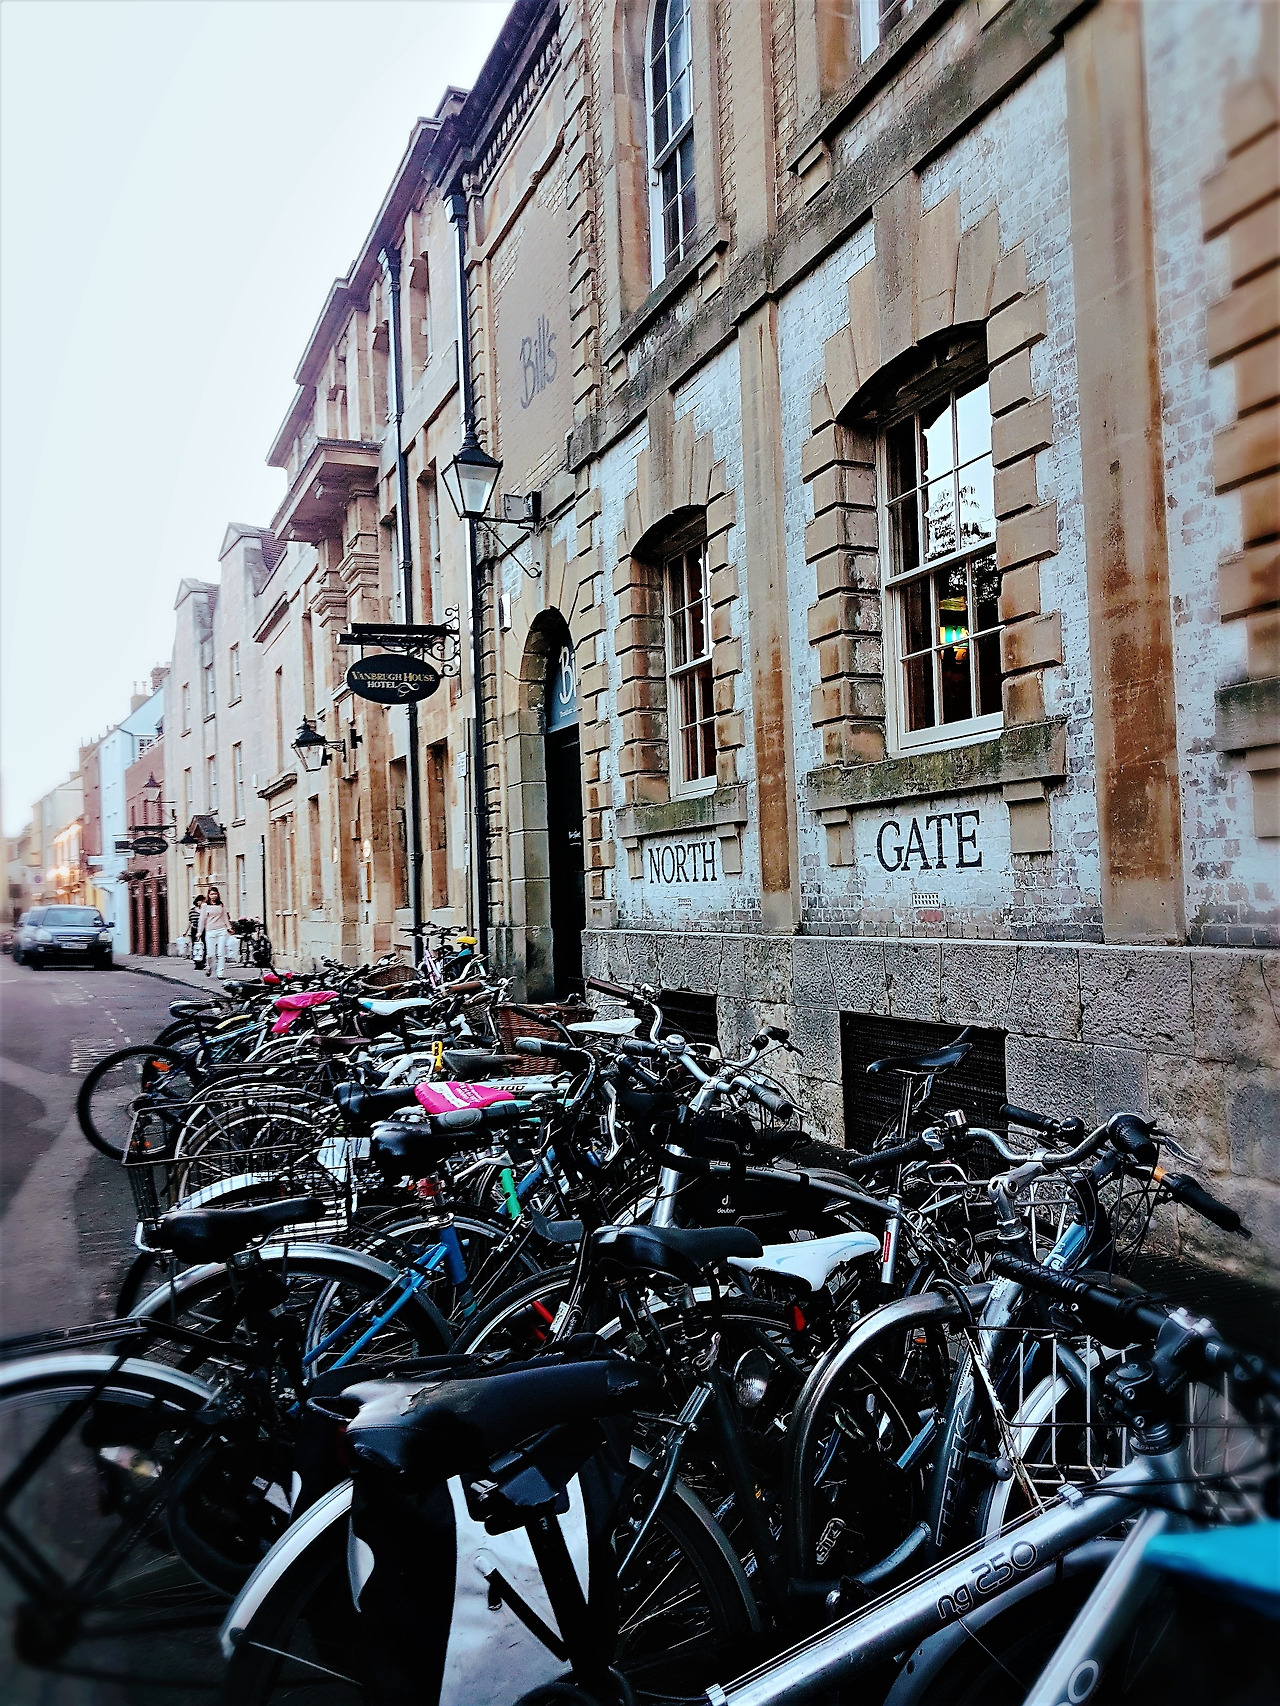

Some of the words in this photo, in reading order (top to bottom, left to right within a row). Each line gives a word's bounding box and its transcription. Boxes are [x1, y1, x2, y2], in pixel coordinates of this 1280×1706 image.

[519, 314, 558, 409] Bill's
[351, 671, 402, 681] VANBRUGH
[403, 672, 436, 682] HOUSE
[648, 840, 718, 884] NORTH
[876, 810, 983, 873] GATE
[937, 1583, 974, 1619] ng
[971, 1540, 1037, 1594] 250
